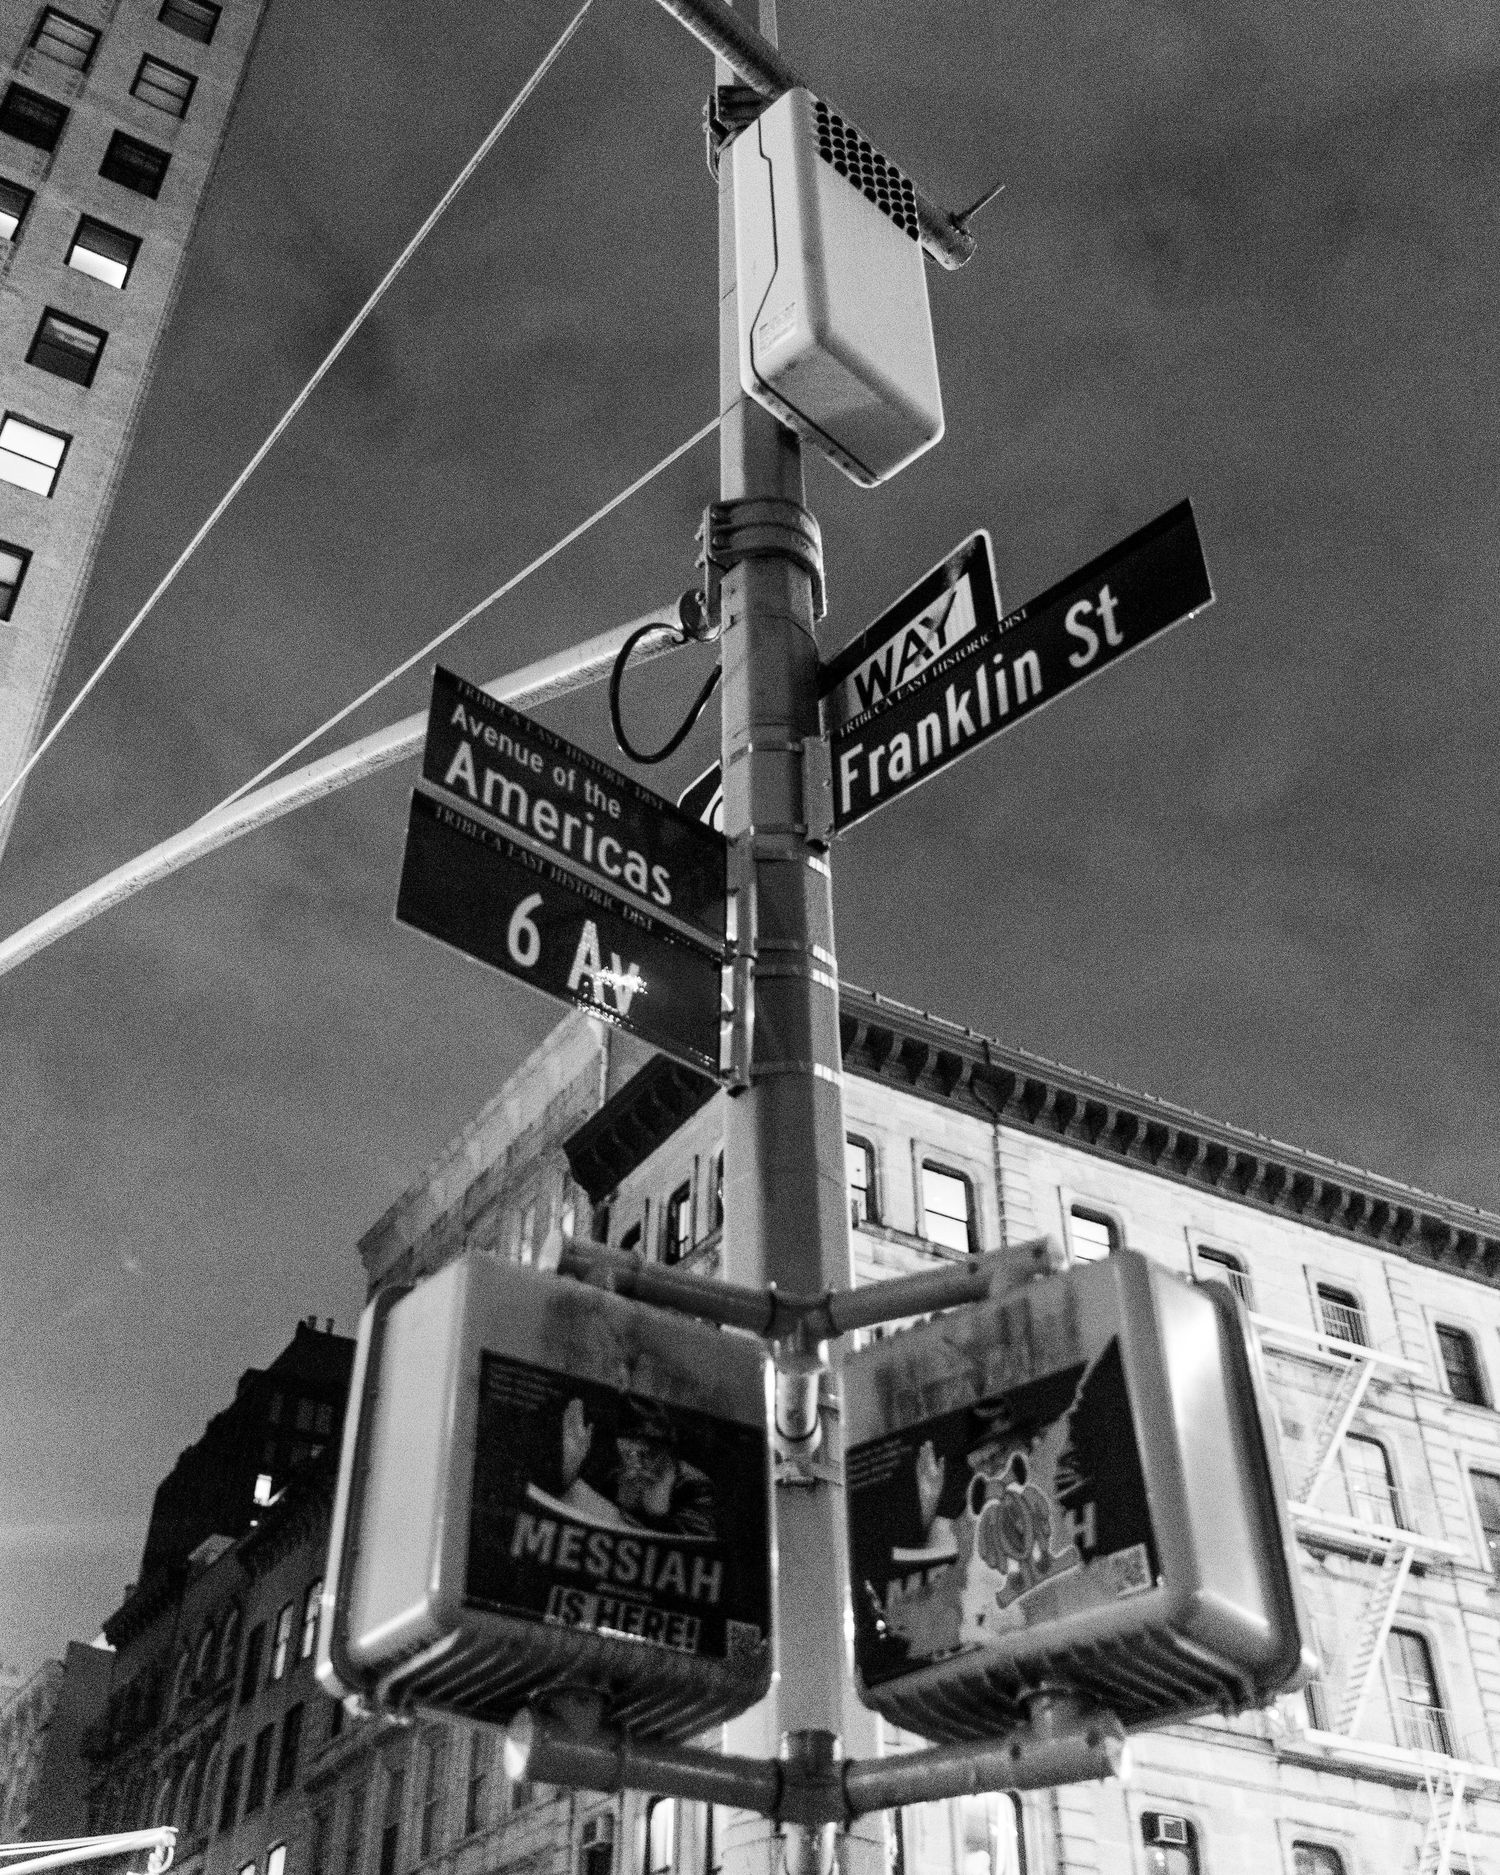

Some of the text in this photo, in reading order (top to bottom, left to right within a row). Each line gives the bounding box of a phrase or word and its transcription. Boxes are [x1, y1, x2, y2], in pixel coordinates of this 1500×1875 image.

[839, 583, 1124, 814] Franklin St
[854, 585, 959, 708] WAY
[896, 671, 928, 700] EAST
[932, 632, 990, 677] HISTORIC
[999, 607, 1028, 635] DIST
[450, 702, 622, 819] Avenue of the
[443, 739, 672, 907] Americas
[507, 892, 641, 1016] 6 Av
[509, 1511, 723, 1604] MESSIAH
